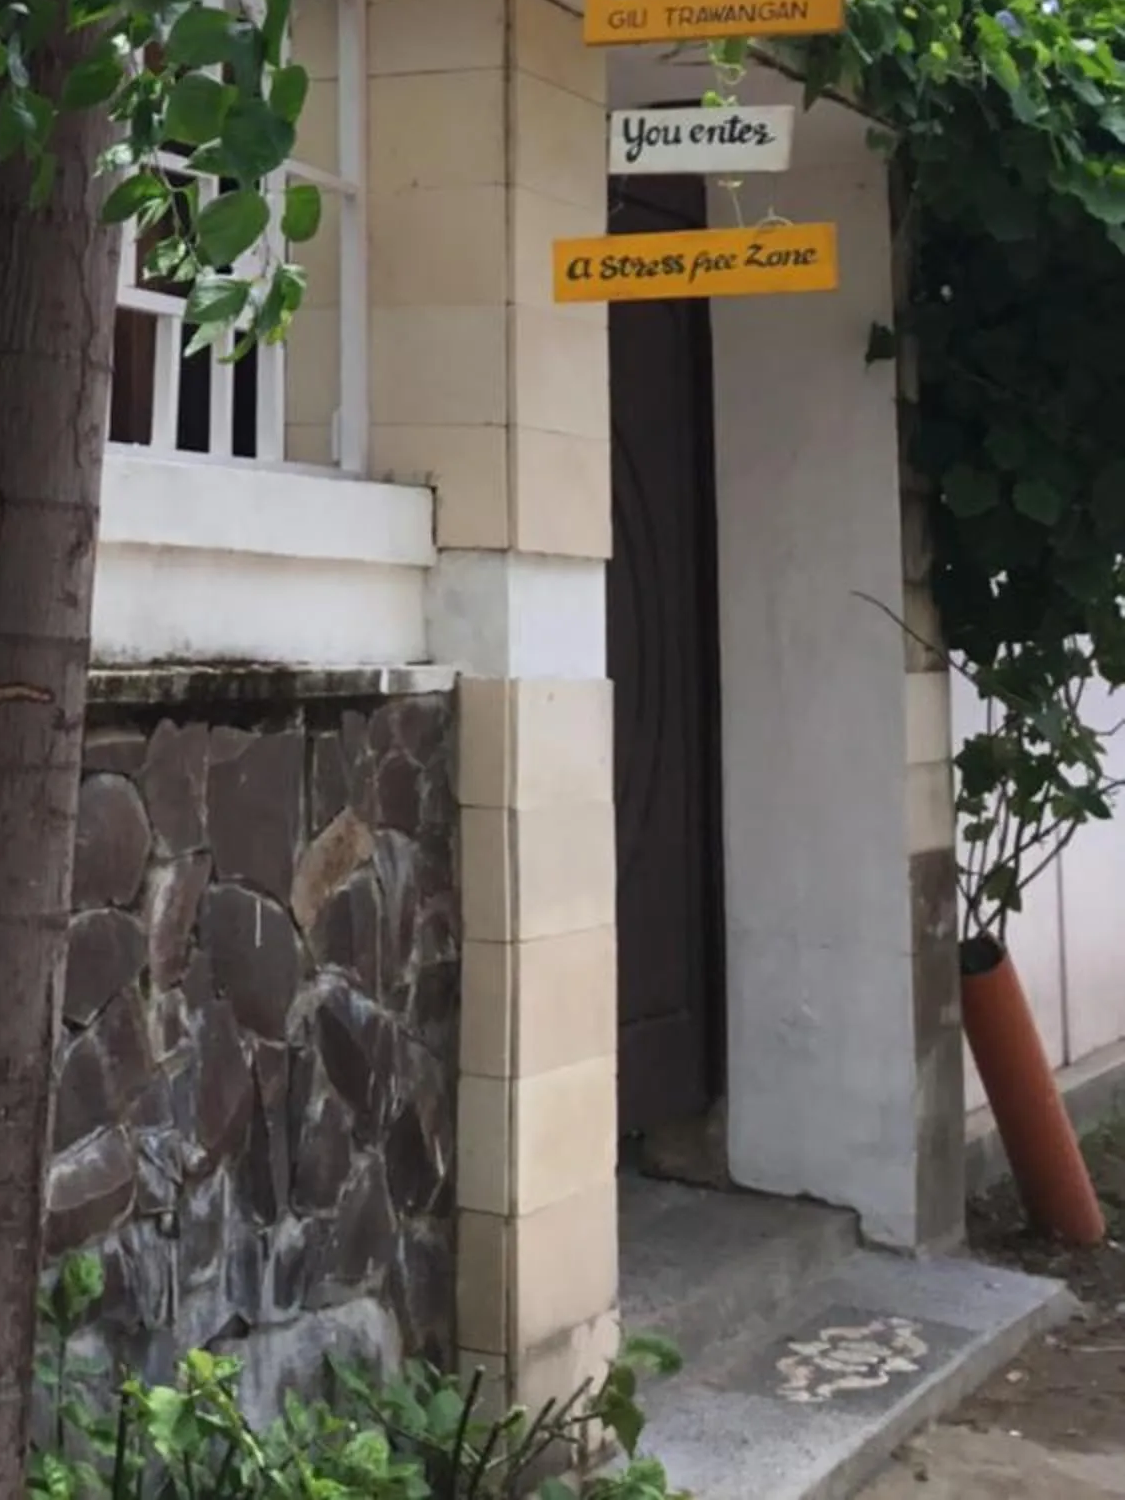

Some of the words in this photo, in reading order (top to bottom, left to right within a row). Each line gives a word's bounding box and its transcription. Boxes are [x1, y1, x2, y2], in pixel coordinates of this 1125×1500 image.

[608, 8, 648, 30] GILI
[665, 0, 808, 26] TRAWANGAN
[623, 115, 682, 164] You
[688, 113, 777, 146] enter
[687, 249, 738, 285] free
